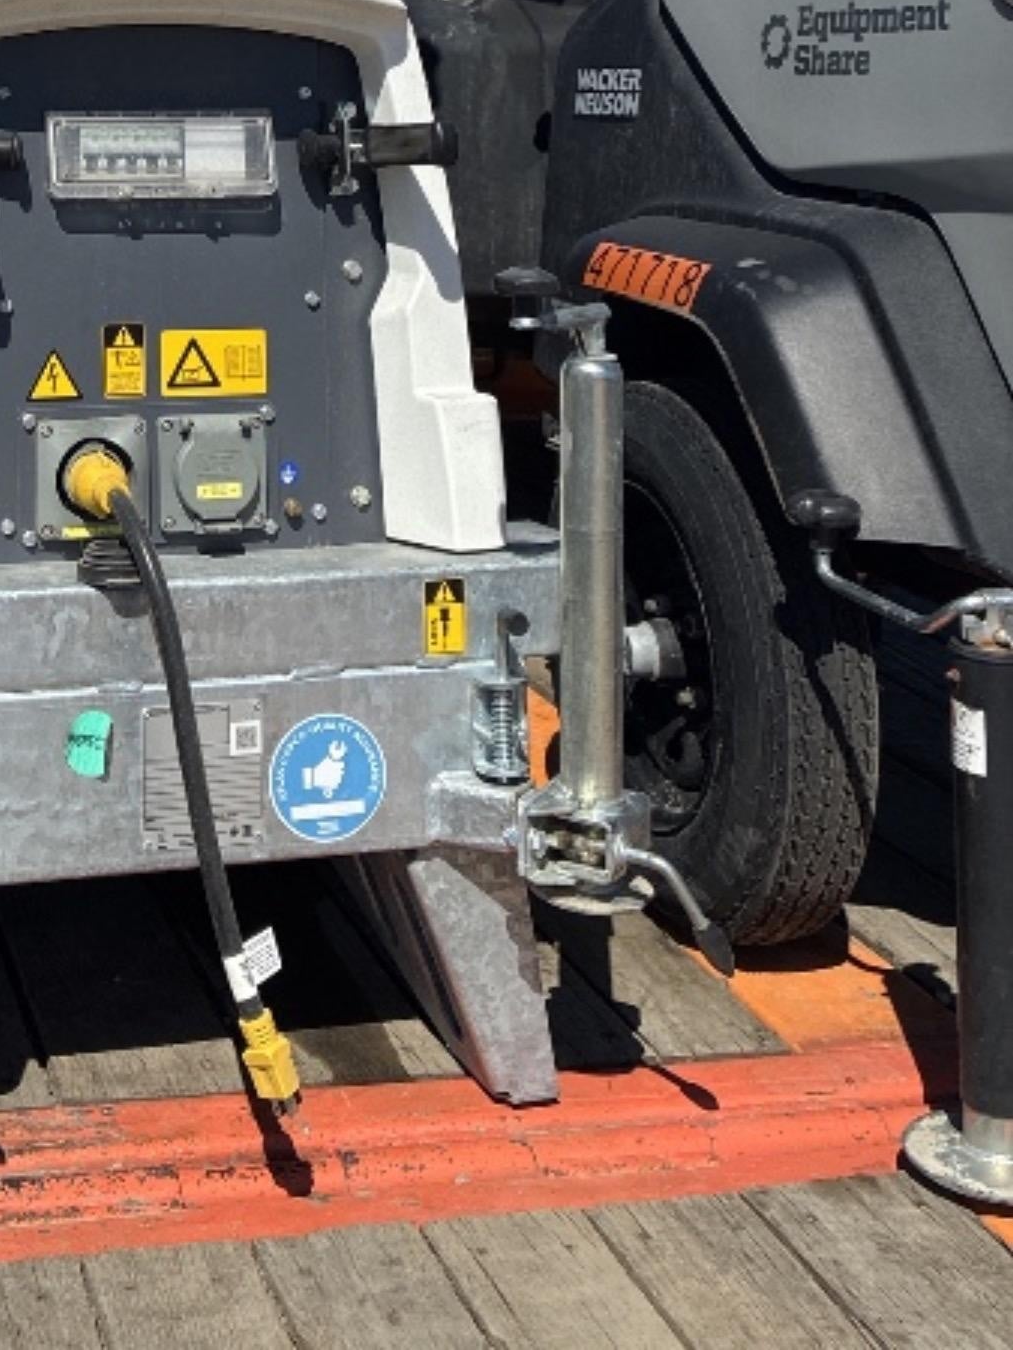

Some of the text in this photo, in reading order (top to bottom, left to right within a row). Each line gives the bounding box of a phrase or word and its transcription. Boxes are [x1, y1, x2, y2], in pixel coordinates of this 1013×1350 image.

[794, 45, 870, 75] Share
[577, 68, 642, 90] WACKER
[575, 92, 639, 116] NEUSON
